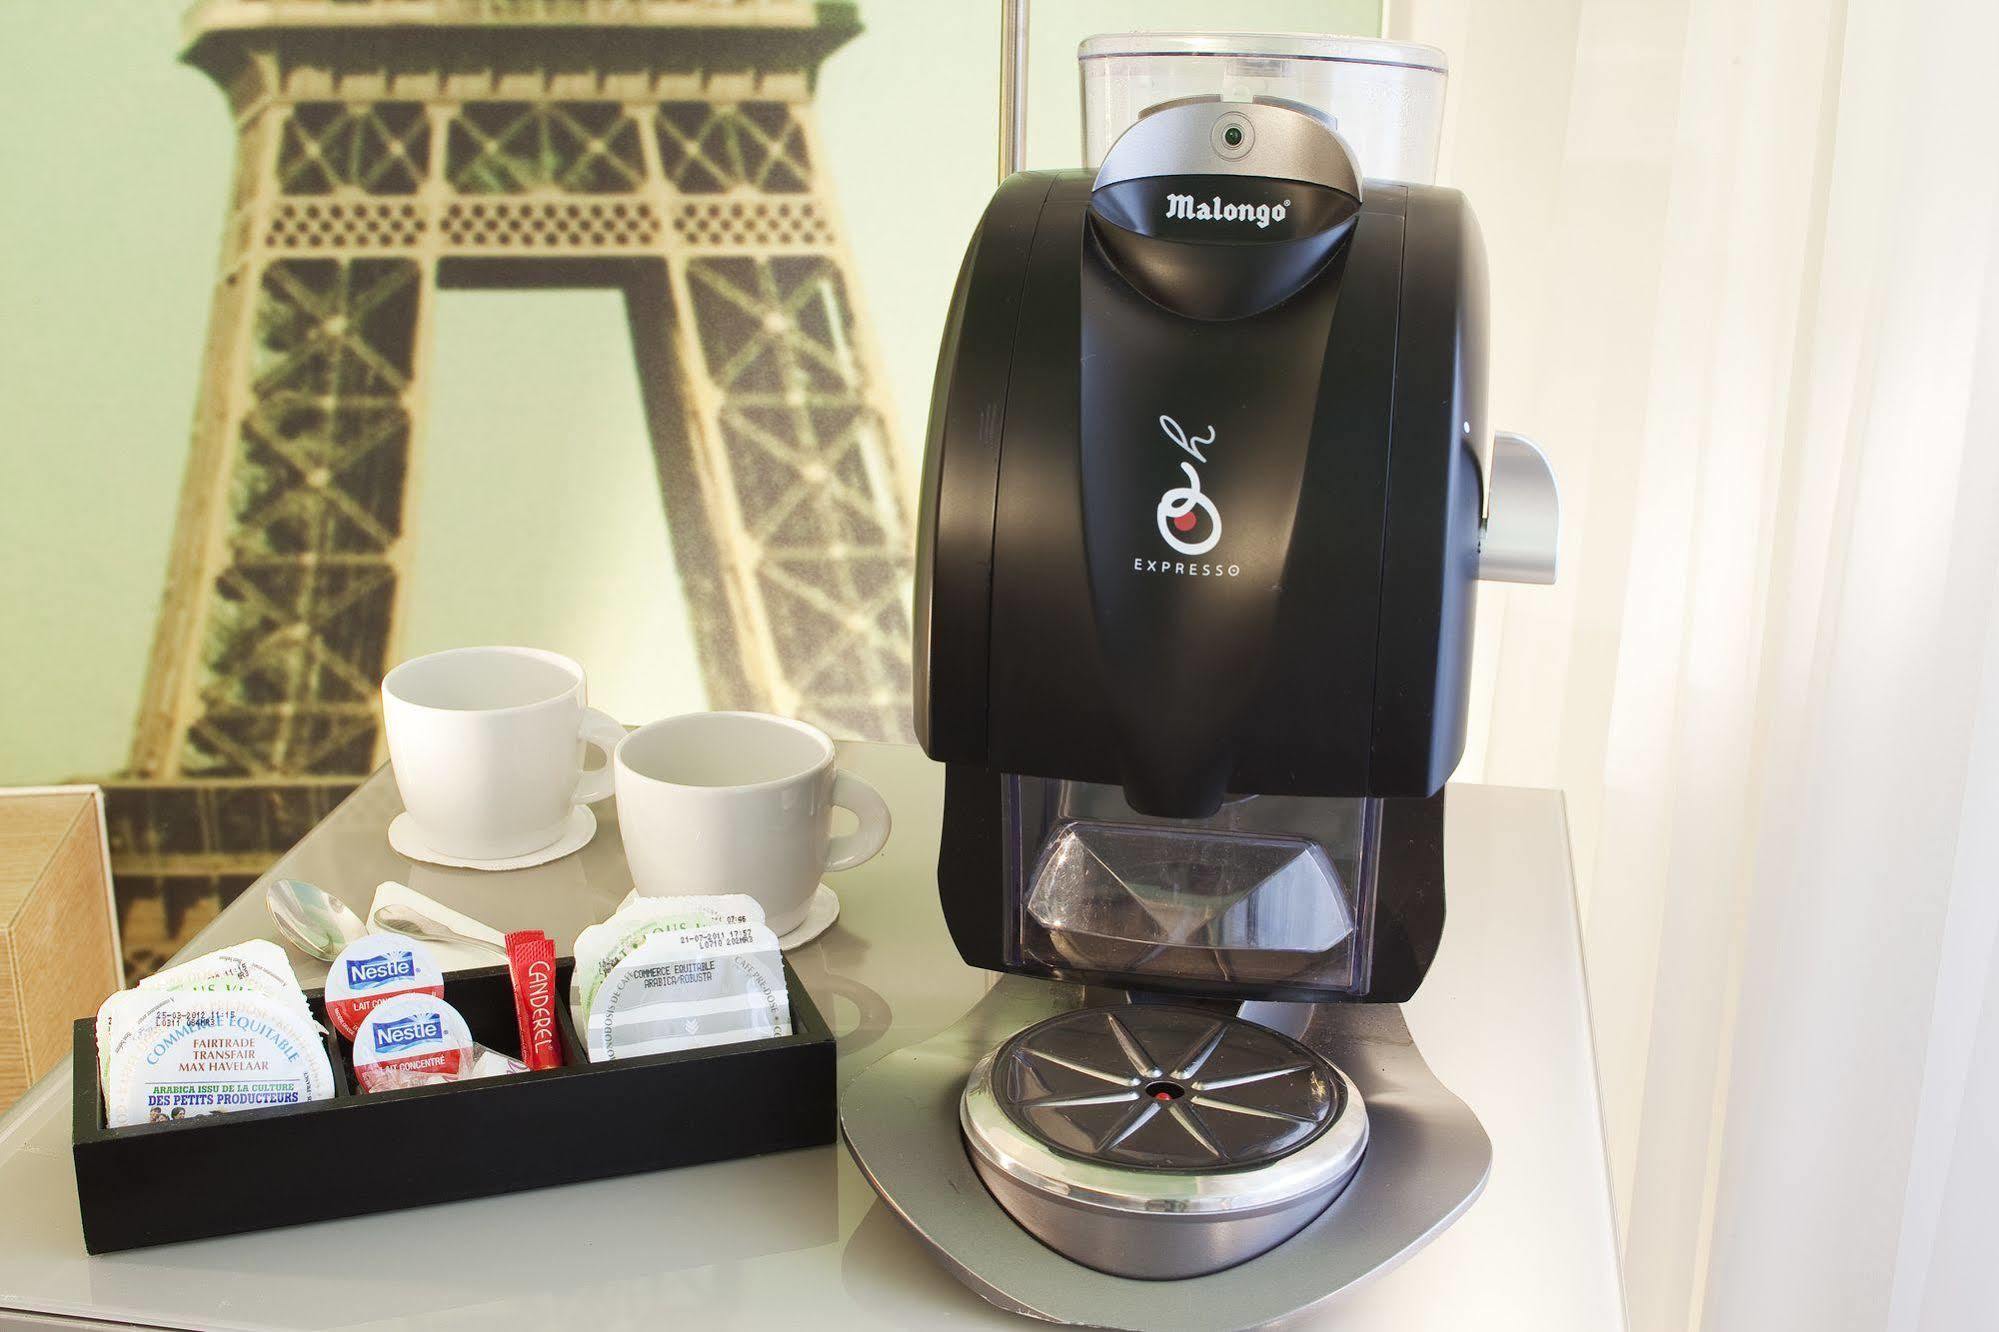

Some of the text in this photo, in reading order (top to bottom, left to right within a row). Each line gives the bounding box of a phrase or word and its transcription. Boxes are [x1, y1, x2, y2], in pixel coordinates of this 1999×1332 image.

[1165, 193, 1286, 229] Malongo
[1134, 557, 1240, 577] EXPRESSO
[633, 965, 671, 980] COMMERCE
[674, 960, 716, 974] EQUITABLE
[353, 1000, 371, 1012] LAIT
[529, 961, 554, 1053] CANDEREL
[193, 1038, 256, 1049] FAIRTRADE
[193, 1049, 256, 1060] TRANSFAIR
[178, 1061, 269, 1072] MAX HAVELAAR
[153, 1083, 295, 1094] ARABICA ISSU DE LA CULTURE
[148, 1094, 171, 1107] DES
[173, 1093, 214, 1106] PETITS
[217, 1092, 299, 1105] PRODUCTEURS
